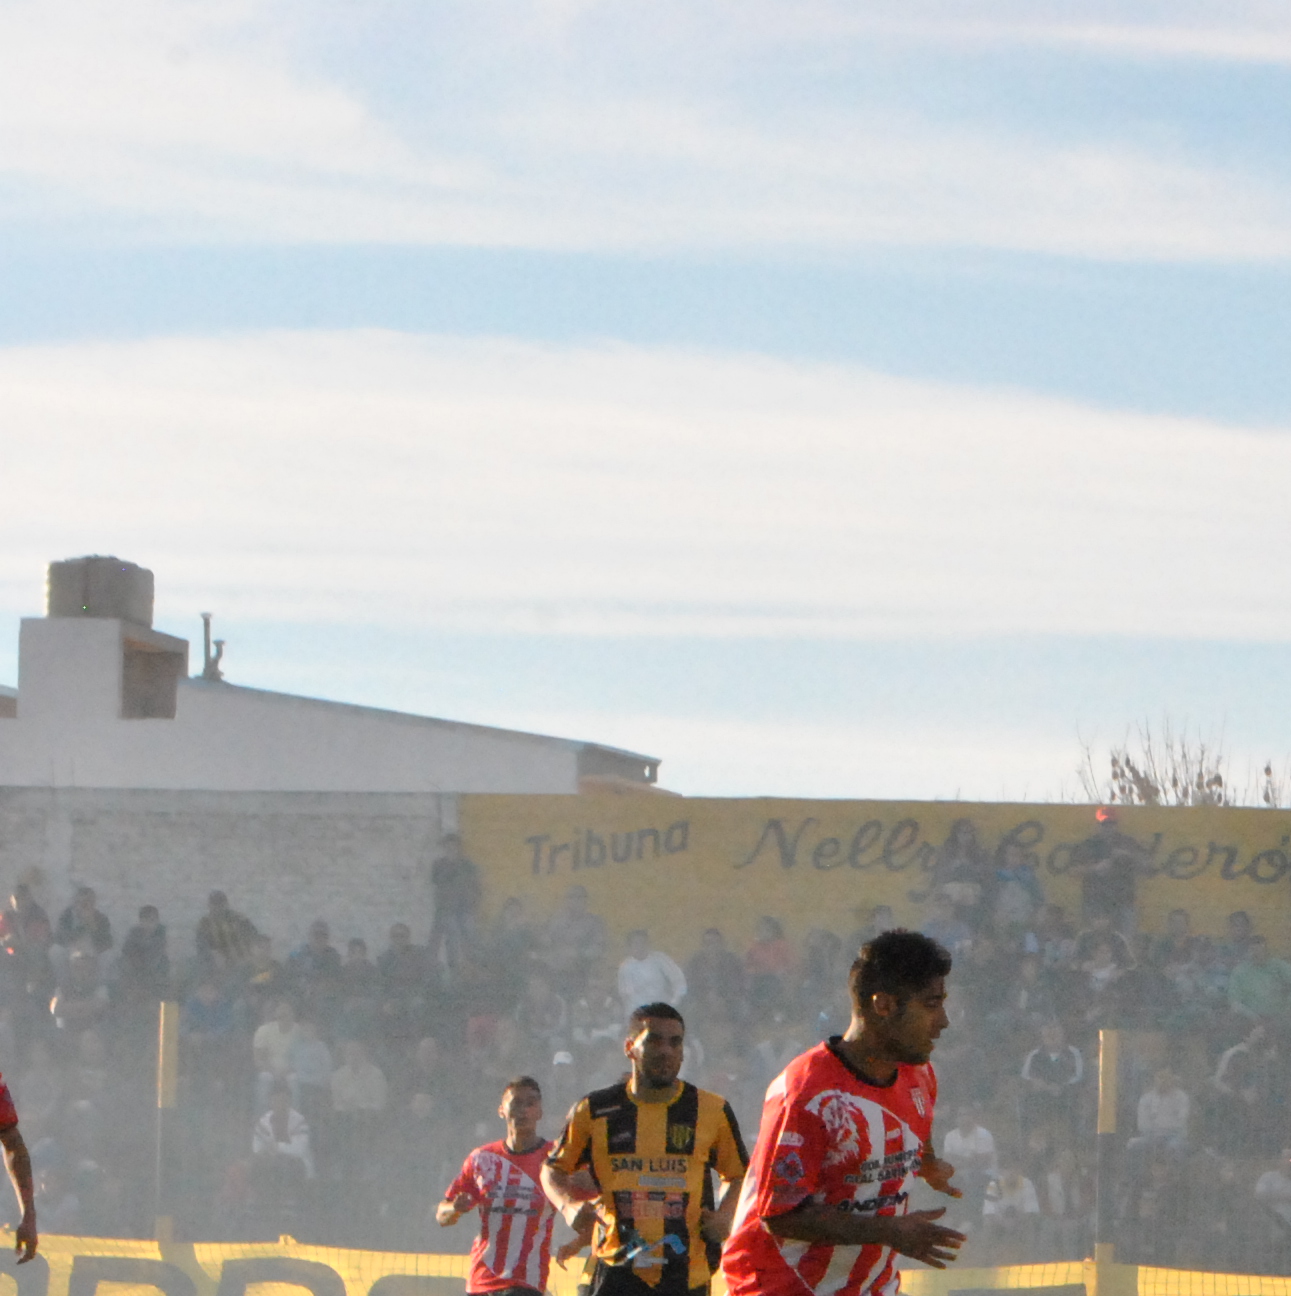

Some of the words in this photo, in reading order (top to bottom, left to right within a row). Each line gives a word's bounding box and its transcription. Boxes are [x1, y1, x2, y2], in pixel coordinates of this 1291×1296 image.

[525, 819, 691, 876] Tribuna
[610, 1157, 644, 1173] SAN
[649, 1157, 688, 1174] LUIS
